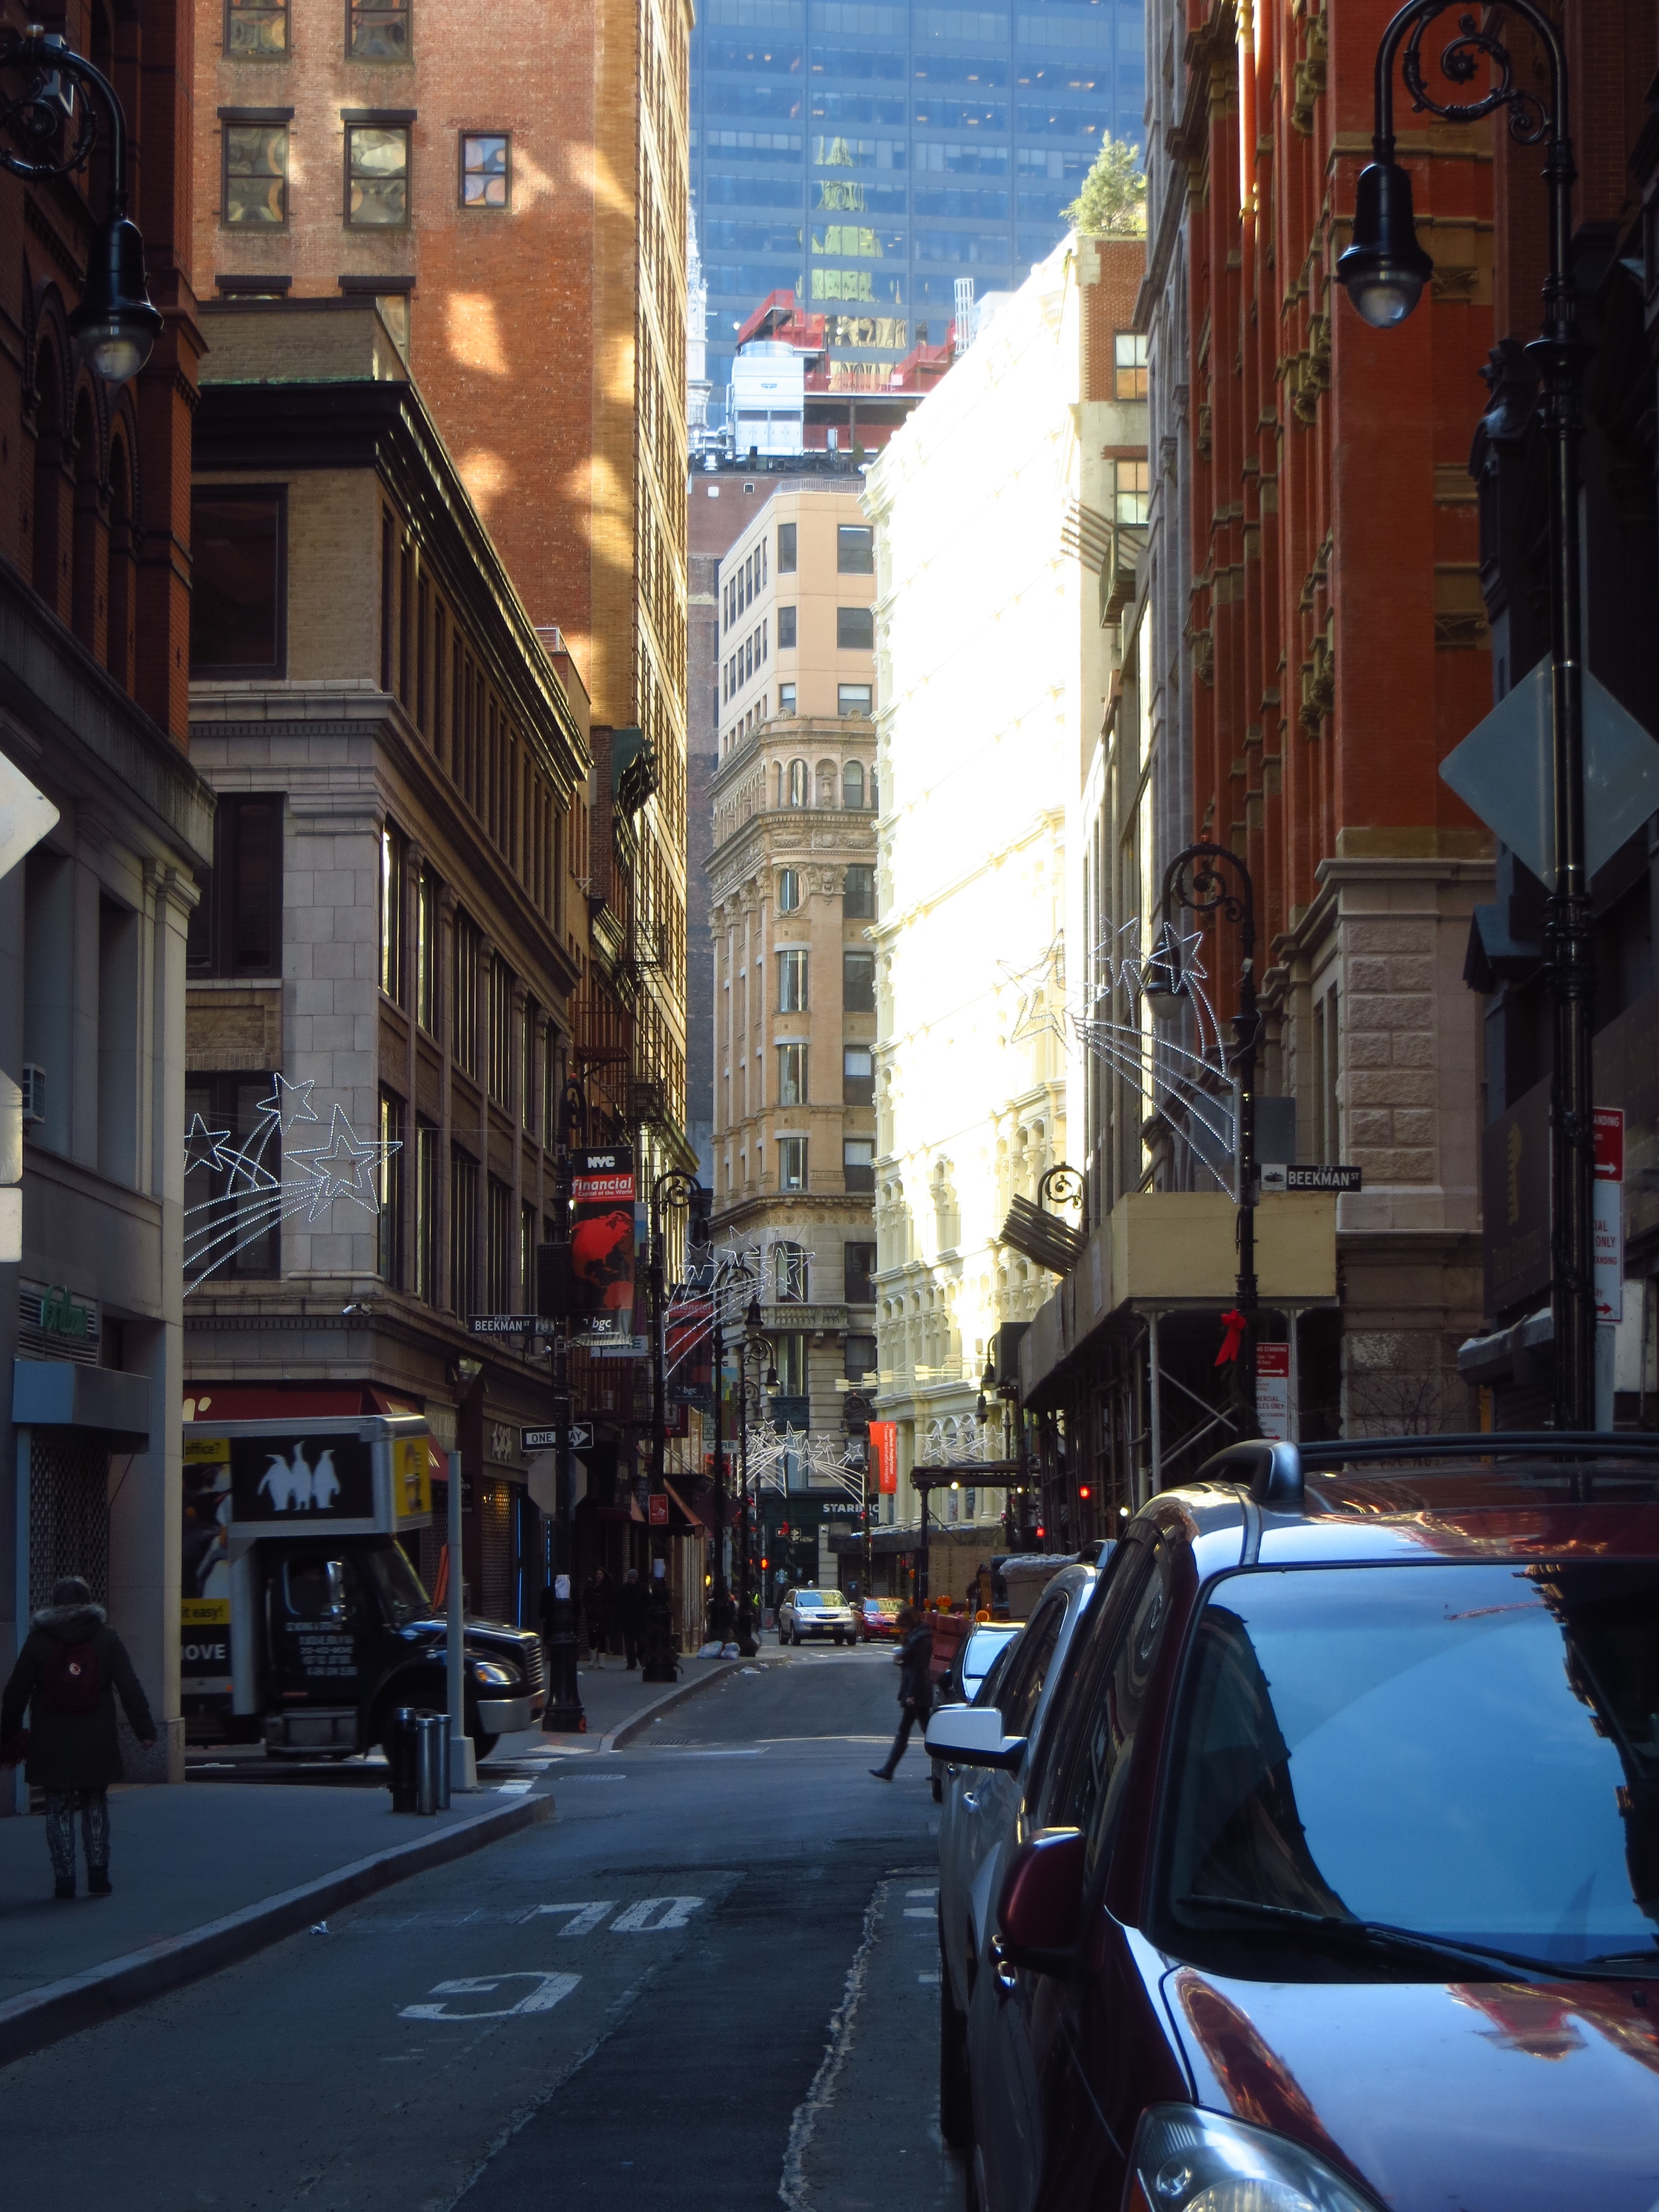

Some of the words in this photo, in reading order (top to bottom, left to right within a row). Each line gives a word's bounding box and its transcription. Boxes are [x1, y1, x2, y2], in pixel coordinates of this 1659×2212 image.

[1593, 1115, 1619, 1127] ANDING
[587, 1156, 615, 1168] NYC
[1288, 1171, 1349, 1186] BEEKMAN
[572, 1177, 632, 1195] financial
[1596, 1236, 1615, 1248] ONLY
[474, 1321, 522, 1331] BEEKMAN
[592, 1317, 611, 1331] bgc
[683, 1386, 697, 1395] bgc
[532, 1434, 552, 1443] ONE
[569, 1432, 581, 1440] AY
[823, 1503, 879, 1512] STARBC
